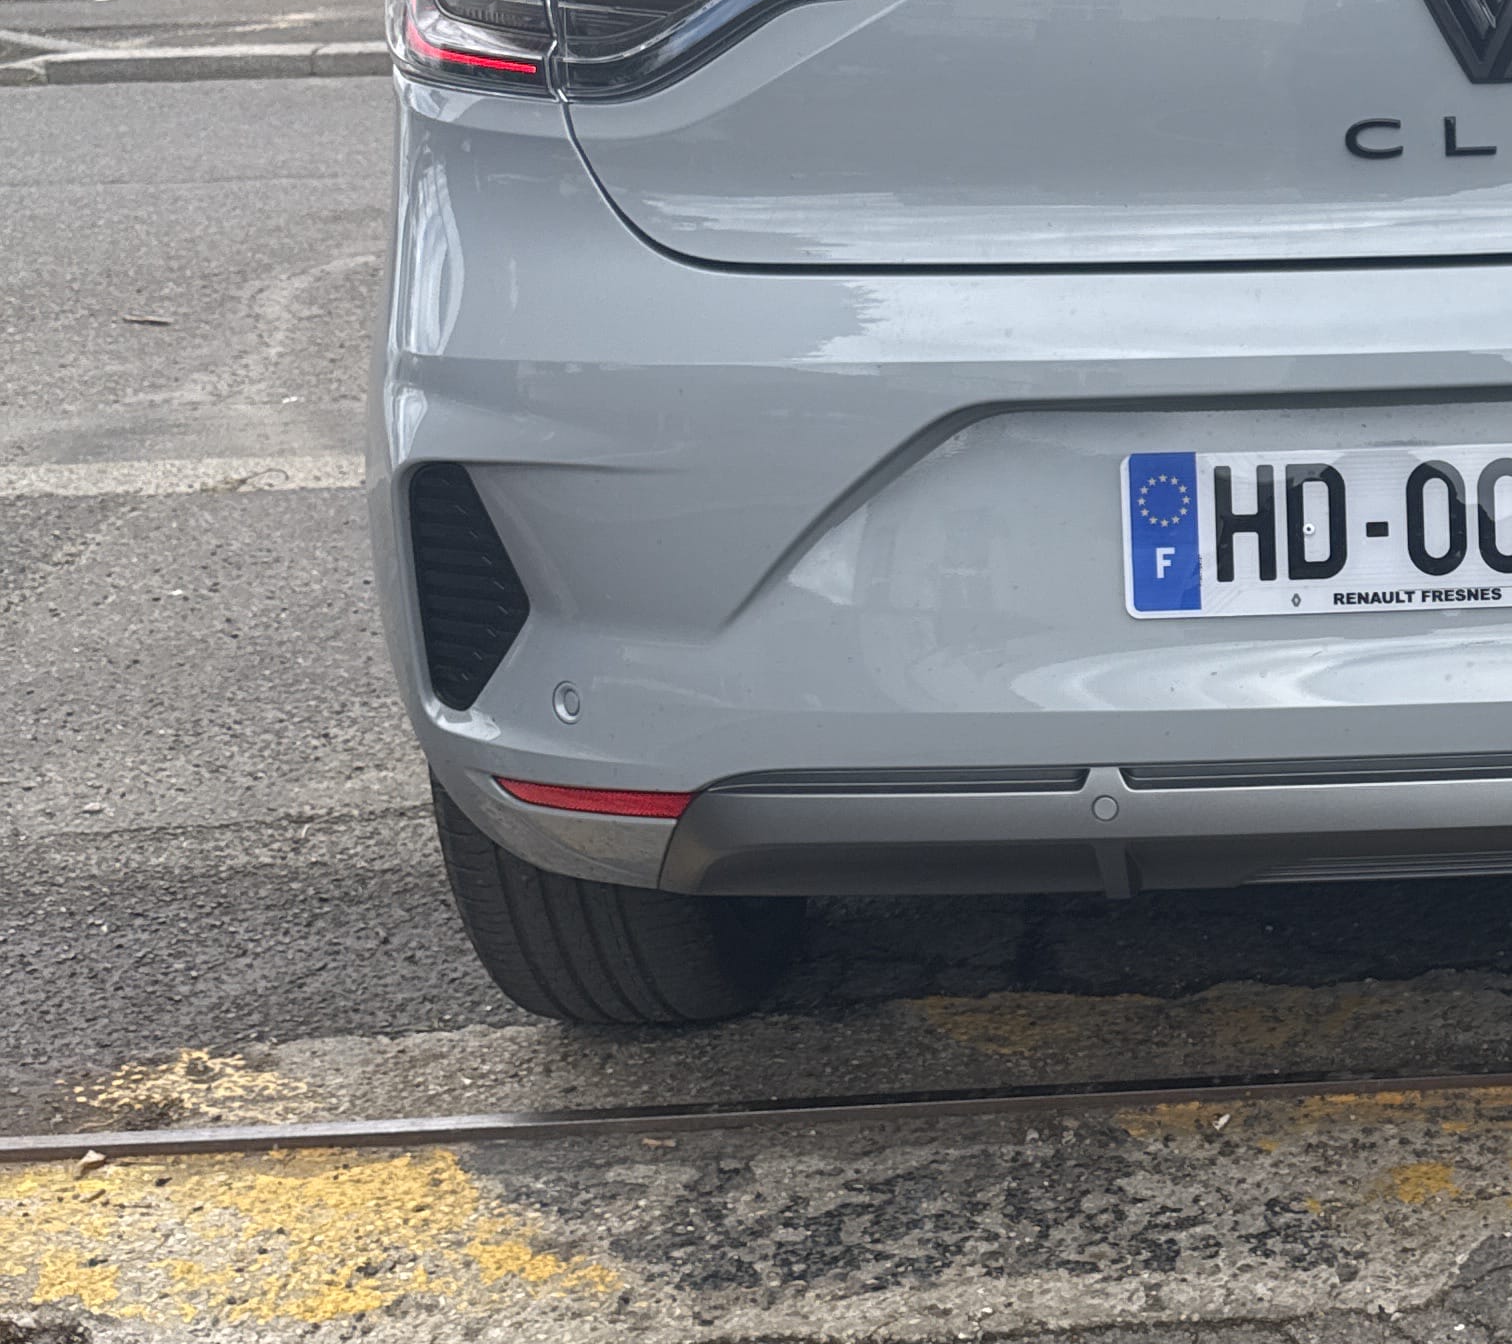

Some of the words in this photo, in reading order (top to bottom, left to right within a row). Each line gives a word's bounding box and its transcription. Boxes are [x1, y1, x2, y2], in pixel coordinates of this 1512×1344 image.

[1156, 548, 1176, 579] F
[1333, 591, 1415, 605] RENAULT
[1421, 588, 1502, 602] FRESNES
